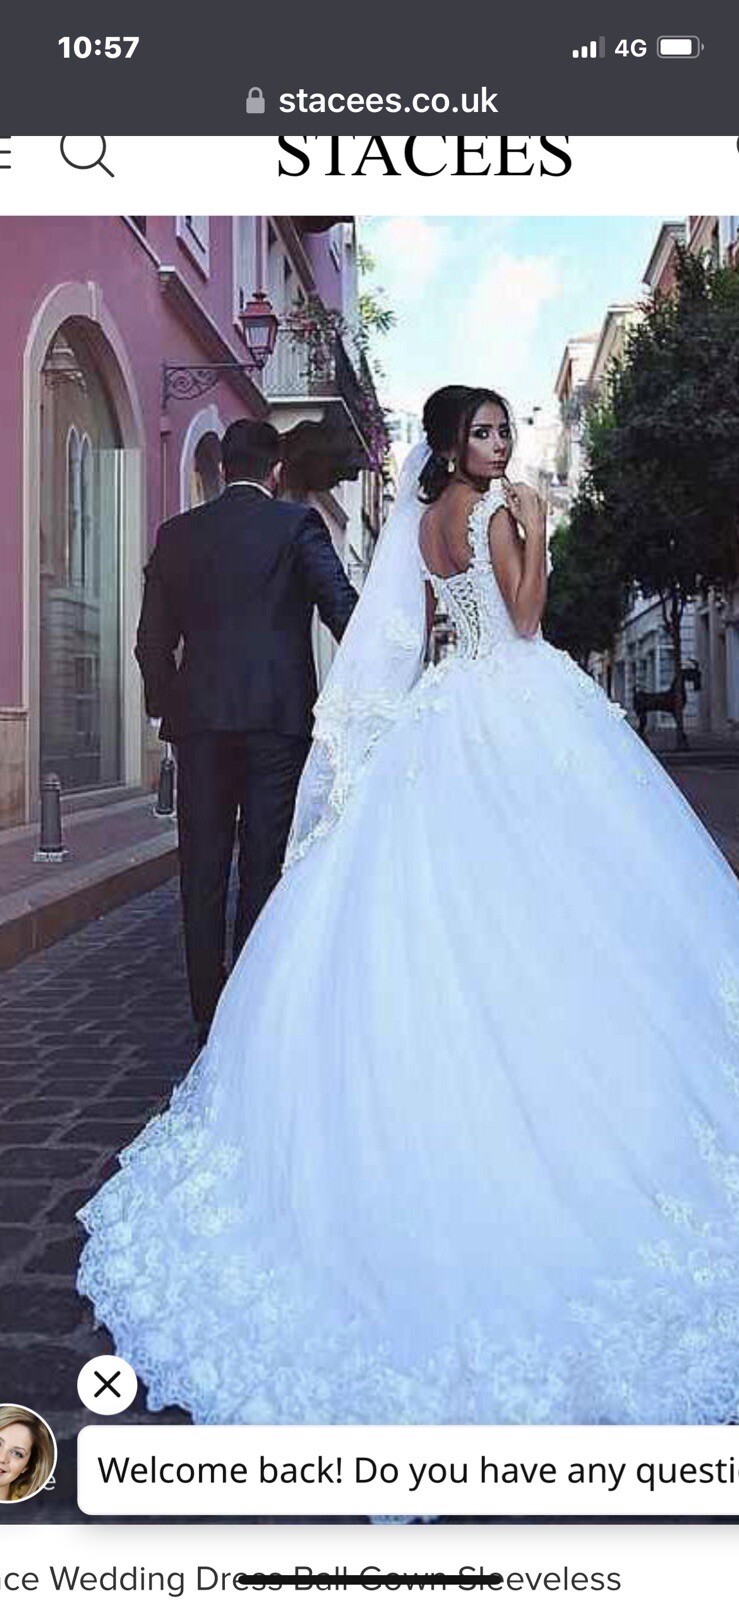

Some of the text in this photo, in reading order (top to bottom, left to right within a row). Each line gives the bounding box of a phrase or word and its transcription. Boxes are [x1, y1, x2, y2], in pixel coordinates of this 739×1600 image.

[58, 35, 140, 59] 10:57
[614, 38, 647, 58] 4G
[279, 86, 499, 113] stacees.co.uk
[277, 136, 572, 177] STACEES
[97, 1455, 739, 1492] Welcome back! Do you have any questi
[0, 1572, 39, 1591] ce
[49, 1566, 184, 1598] Wedding
[458, 1566, 621, 1591] Sleeveless
